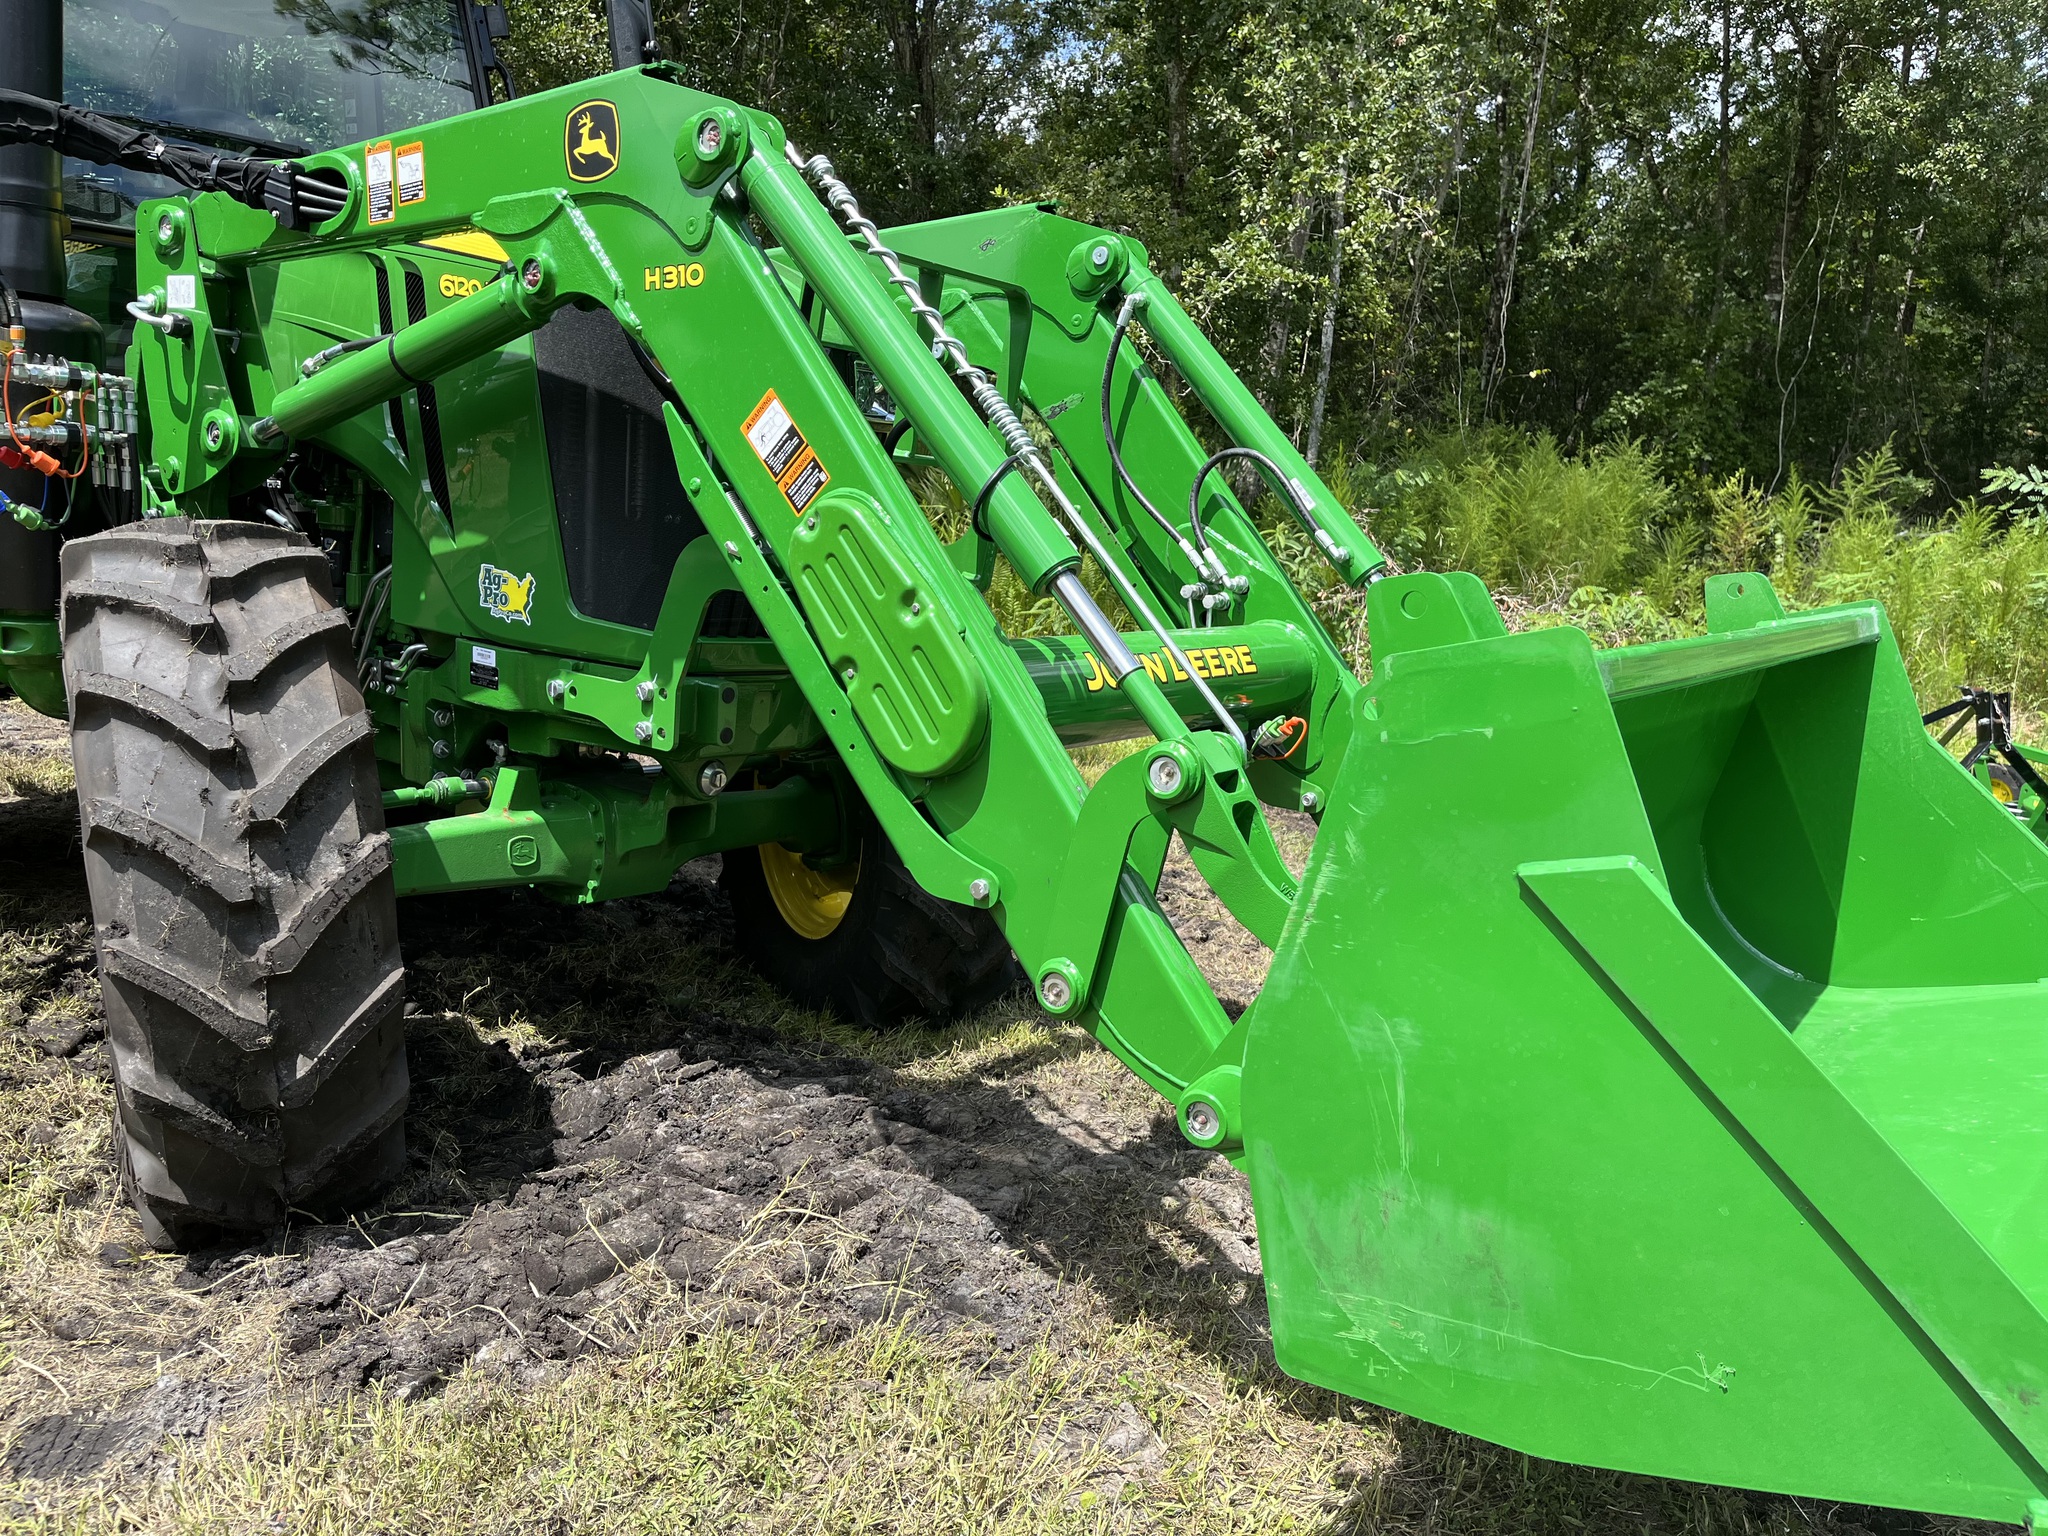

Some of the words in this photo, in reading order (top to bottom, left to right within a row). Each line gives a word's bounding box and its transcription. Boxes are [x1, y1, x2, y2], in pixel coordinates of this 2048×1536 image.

[644, 262, 706, 291] H310
[750, 395, 772, 423] WARNING
[788, 453, 811, 481] WARNING
[482, 585, 509, 606] Pro
